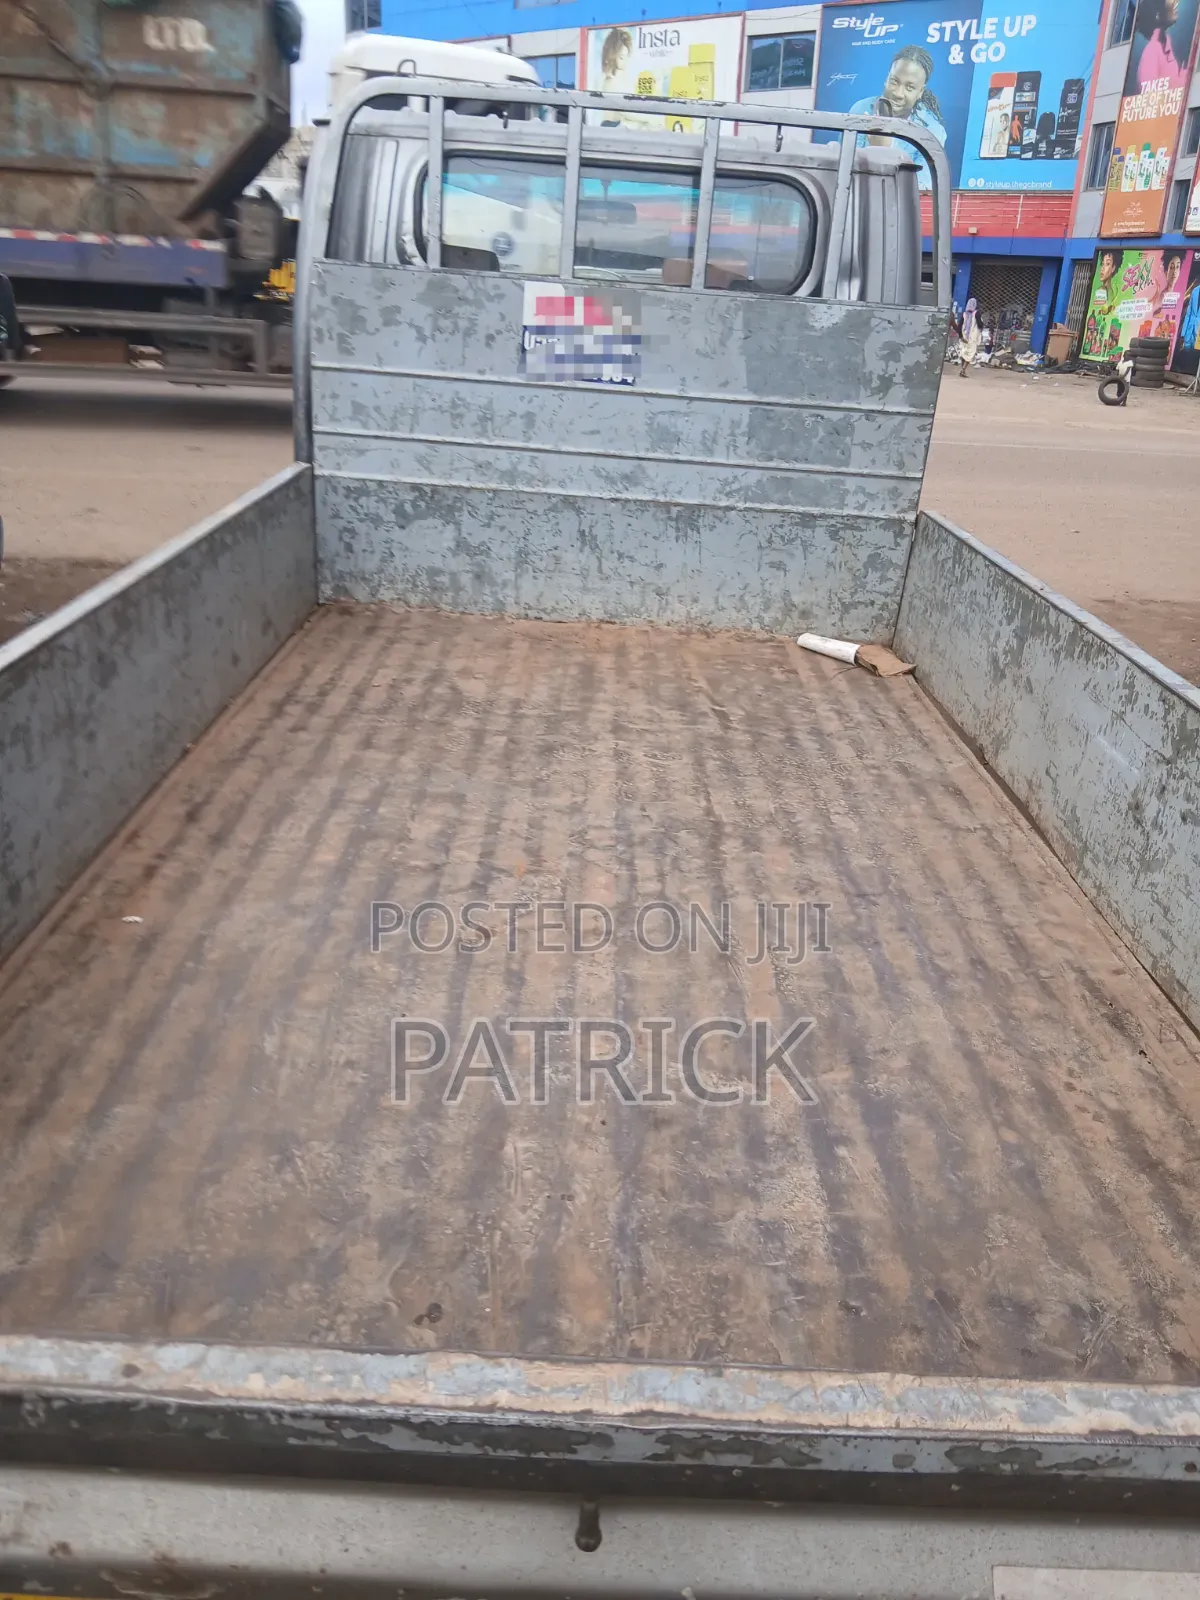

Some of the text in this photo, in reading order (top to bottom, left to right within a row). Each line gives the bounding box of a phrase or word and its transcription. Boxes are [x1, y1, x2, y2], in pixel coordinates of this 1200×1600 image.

[832, 12, 885, 31] Style
[926, 14, 1037, 43] STYLE UP
[638, 27, 681, 49] Insta
[948, 41, 1006, 65] & GO
[1140, 77, 1170, 95] TAKES
[1123, 87, 1184, 111] CARE OF THE
[1121, 101, 1181, 124] FUTURE YOU
